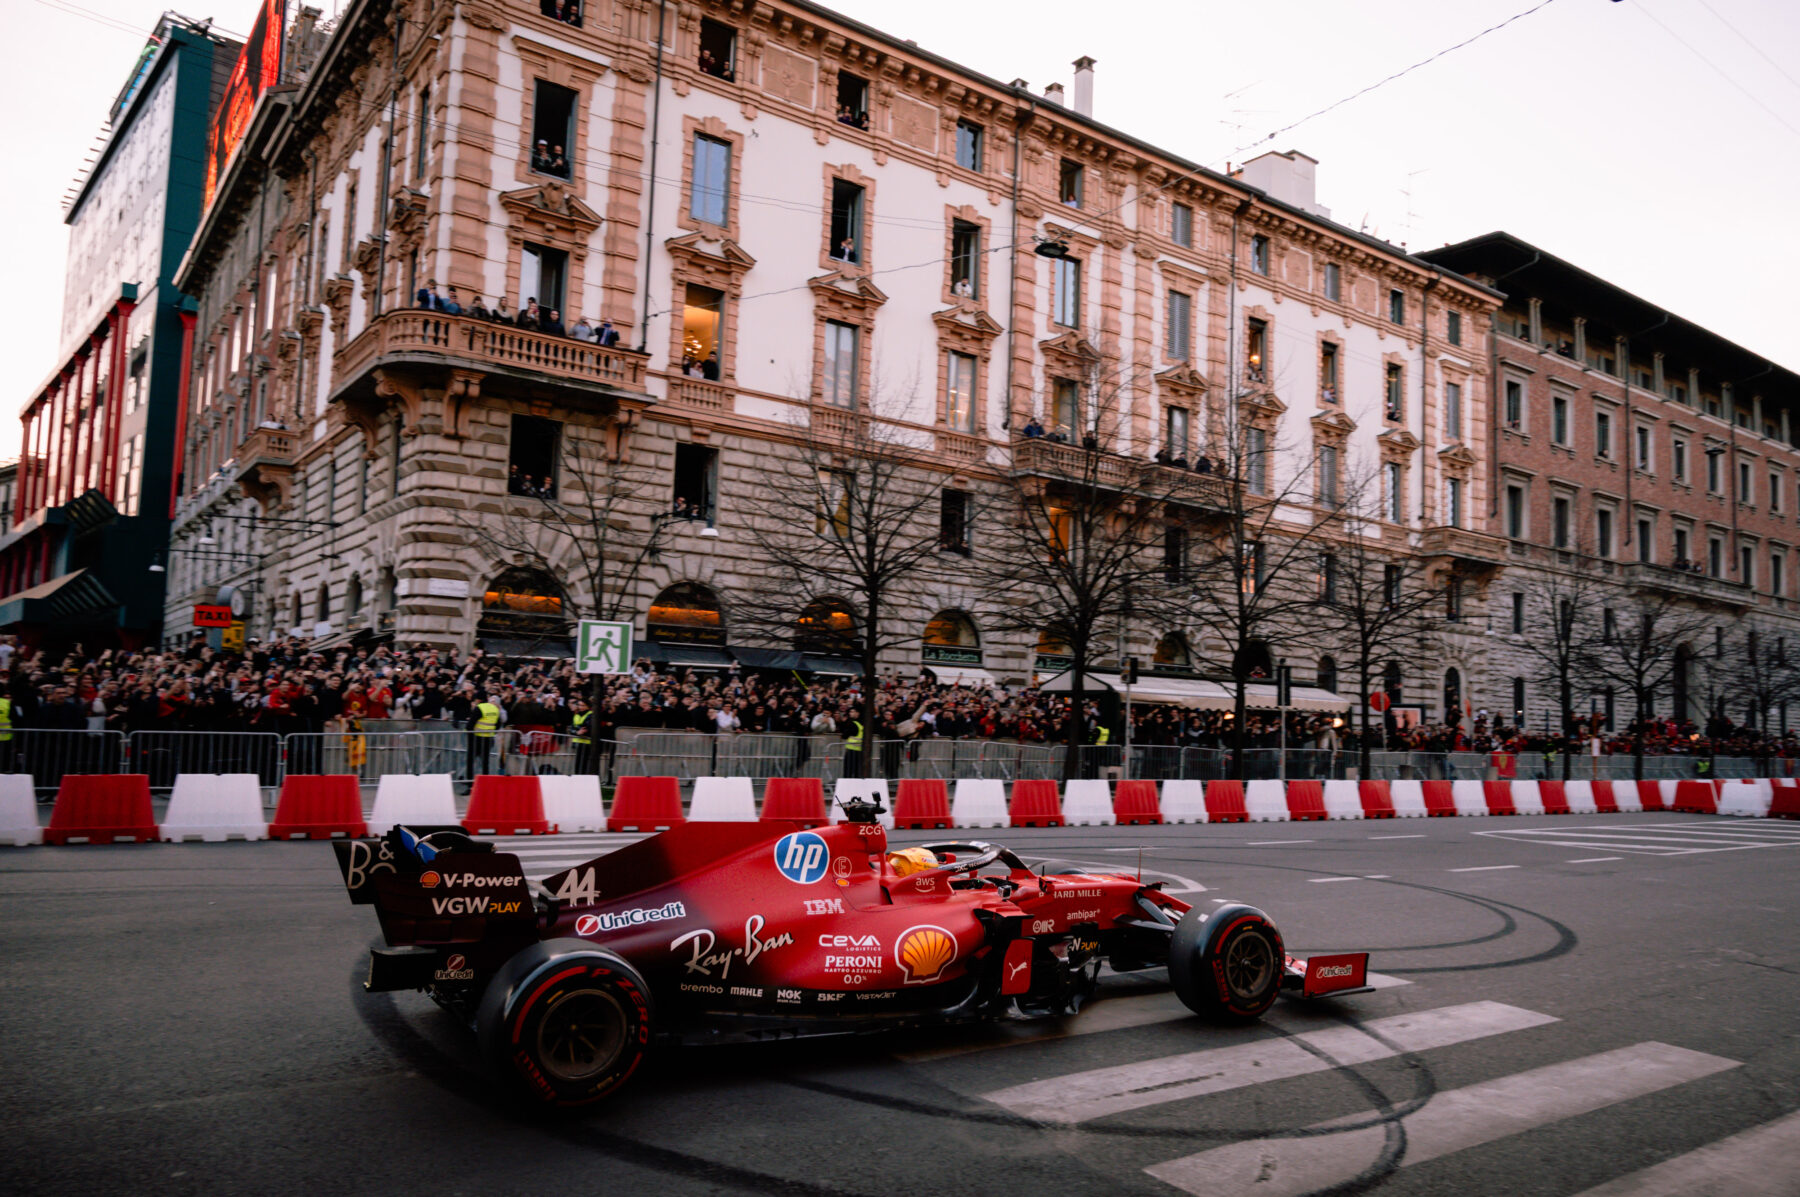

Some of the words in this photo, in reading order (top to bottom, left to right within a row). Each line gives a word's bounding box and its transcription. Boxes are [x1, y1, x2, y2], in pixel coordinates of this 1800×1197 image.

[198, 611, 230, 621] TAXI
[783, 833, 823, 883] hp
[443, 873, 522, 888] V-Power
[556, 866, 601, 907] 44
[916, 877, 935, 886] aws
[1077, 889, 1102, 897] MILLE
[432, 896, 490, 915] VGW
[489, 901, 521, 913] PLAY
[803, 899, 845, 915] IBM
[600, 902, 686, 931] UniCredit
[1081, 941, 1098, 951] PLAY
[825, 955, 882, 969] PERONI
[434, 969, 474, 981] UniCredit
[680, 983, 724, 995] brembo
[730, 986, 763, 998] MAHLE
[776, 989, 802, 1000] NGK
[817, 993, 846, 1002] SKF
[616, 977, 648, 1045] ZERO
